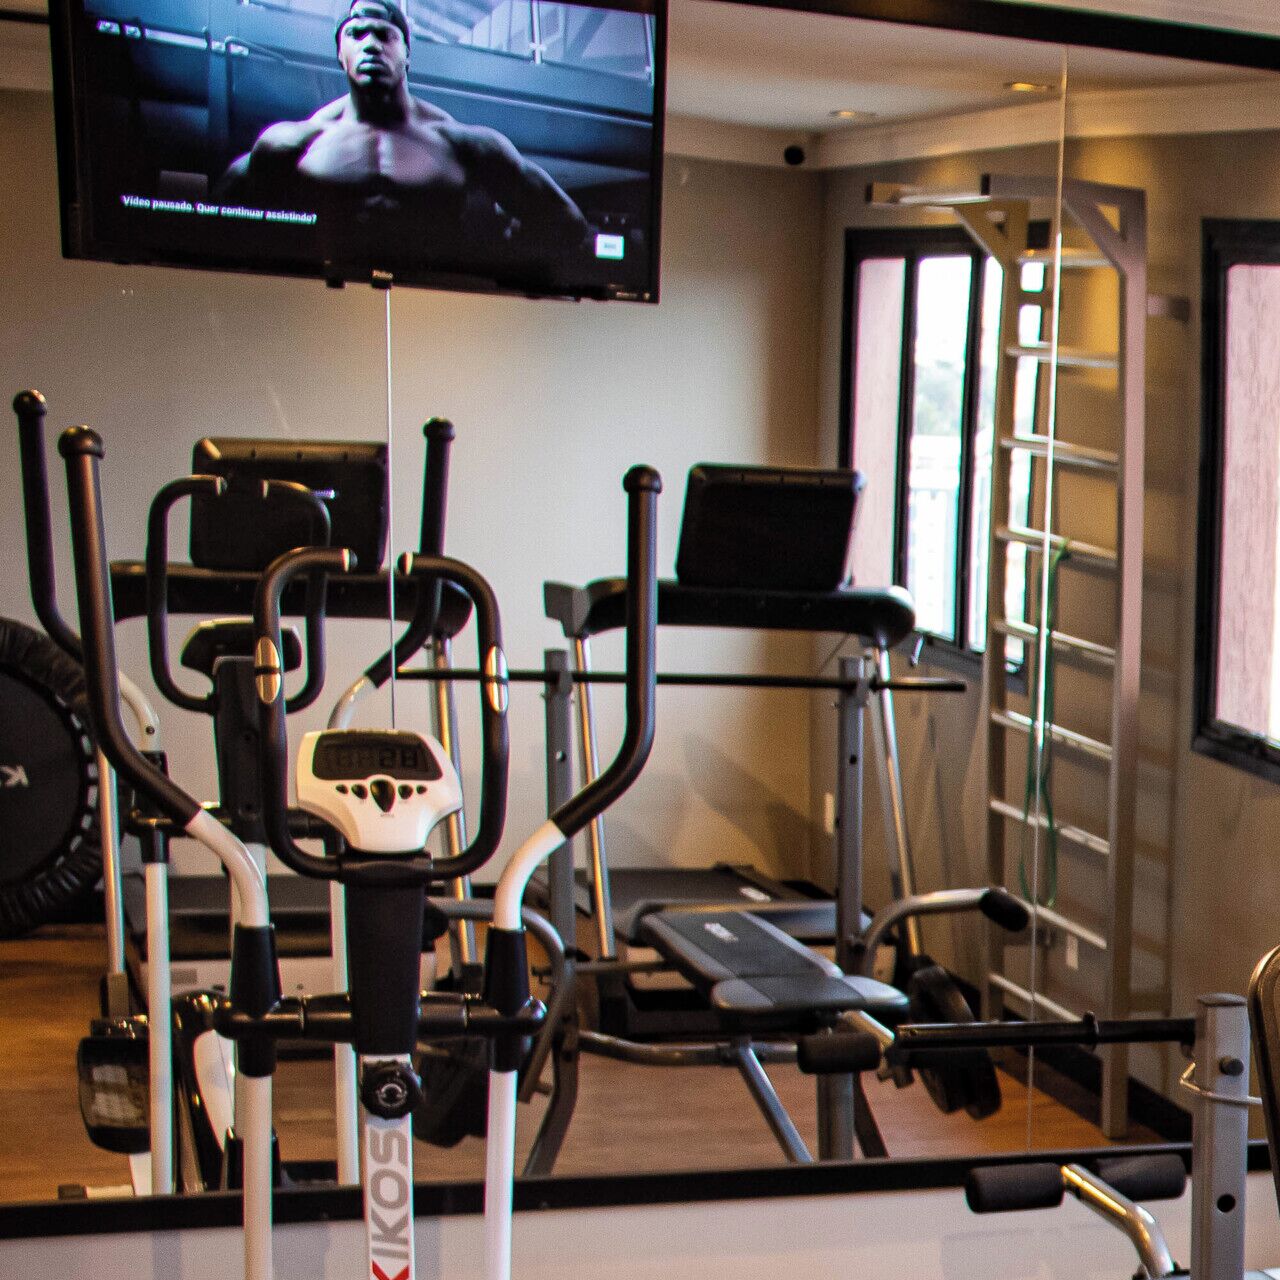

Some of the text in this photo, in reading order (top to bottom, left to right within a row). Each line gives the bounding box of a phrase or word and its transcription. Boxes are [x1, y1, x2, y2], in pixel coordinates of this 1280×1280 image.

[197, 203, 219, 214] Quer
[221, 206, 263, 219] continuar
[265, 211, 317, 224] assistindo?
